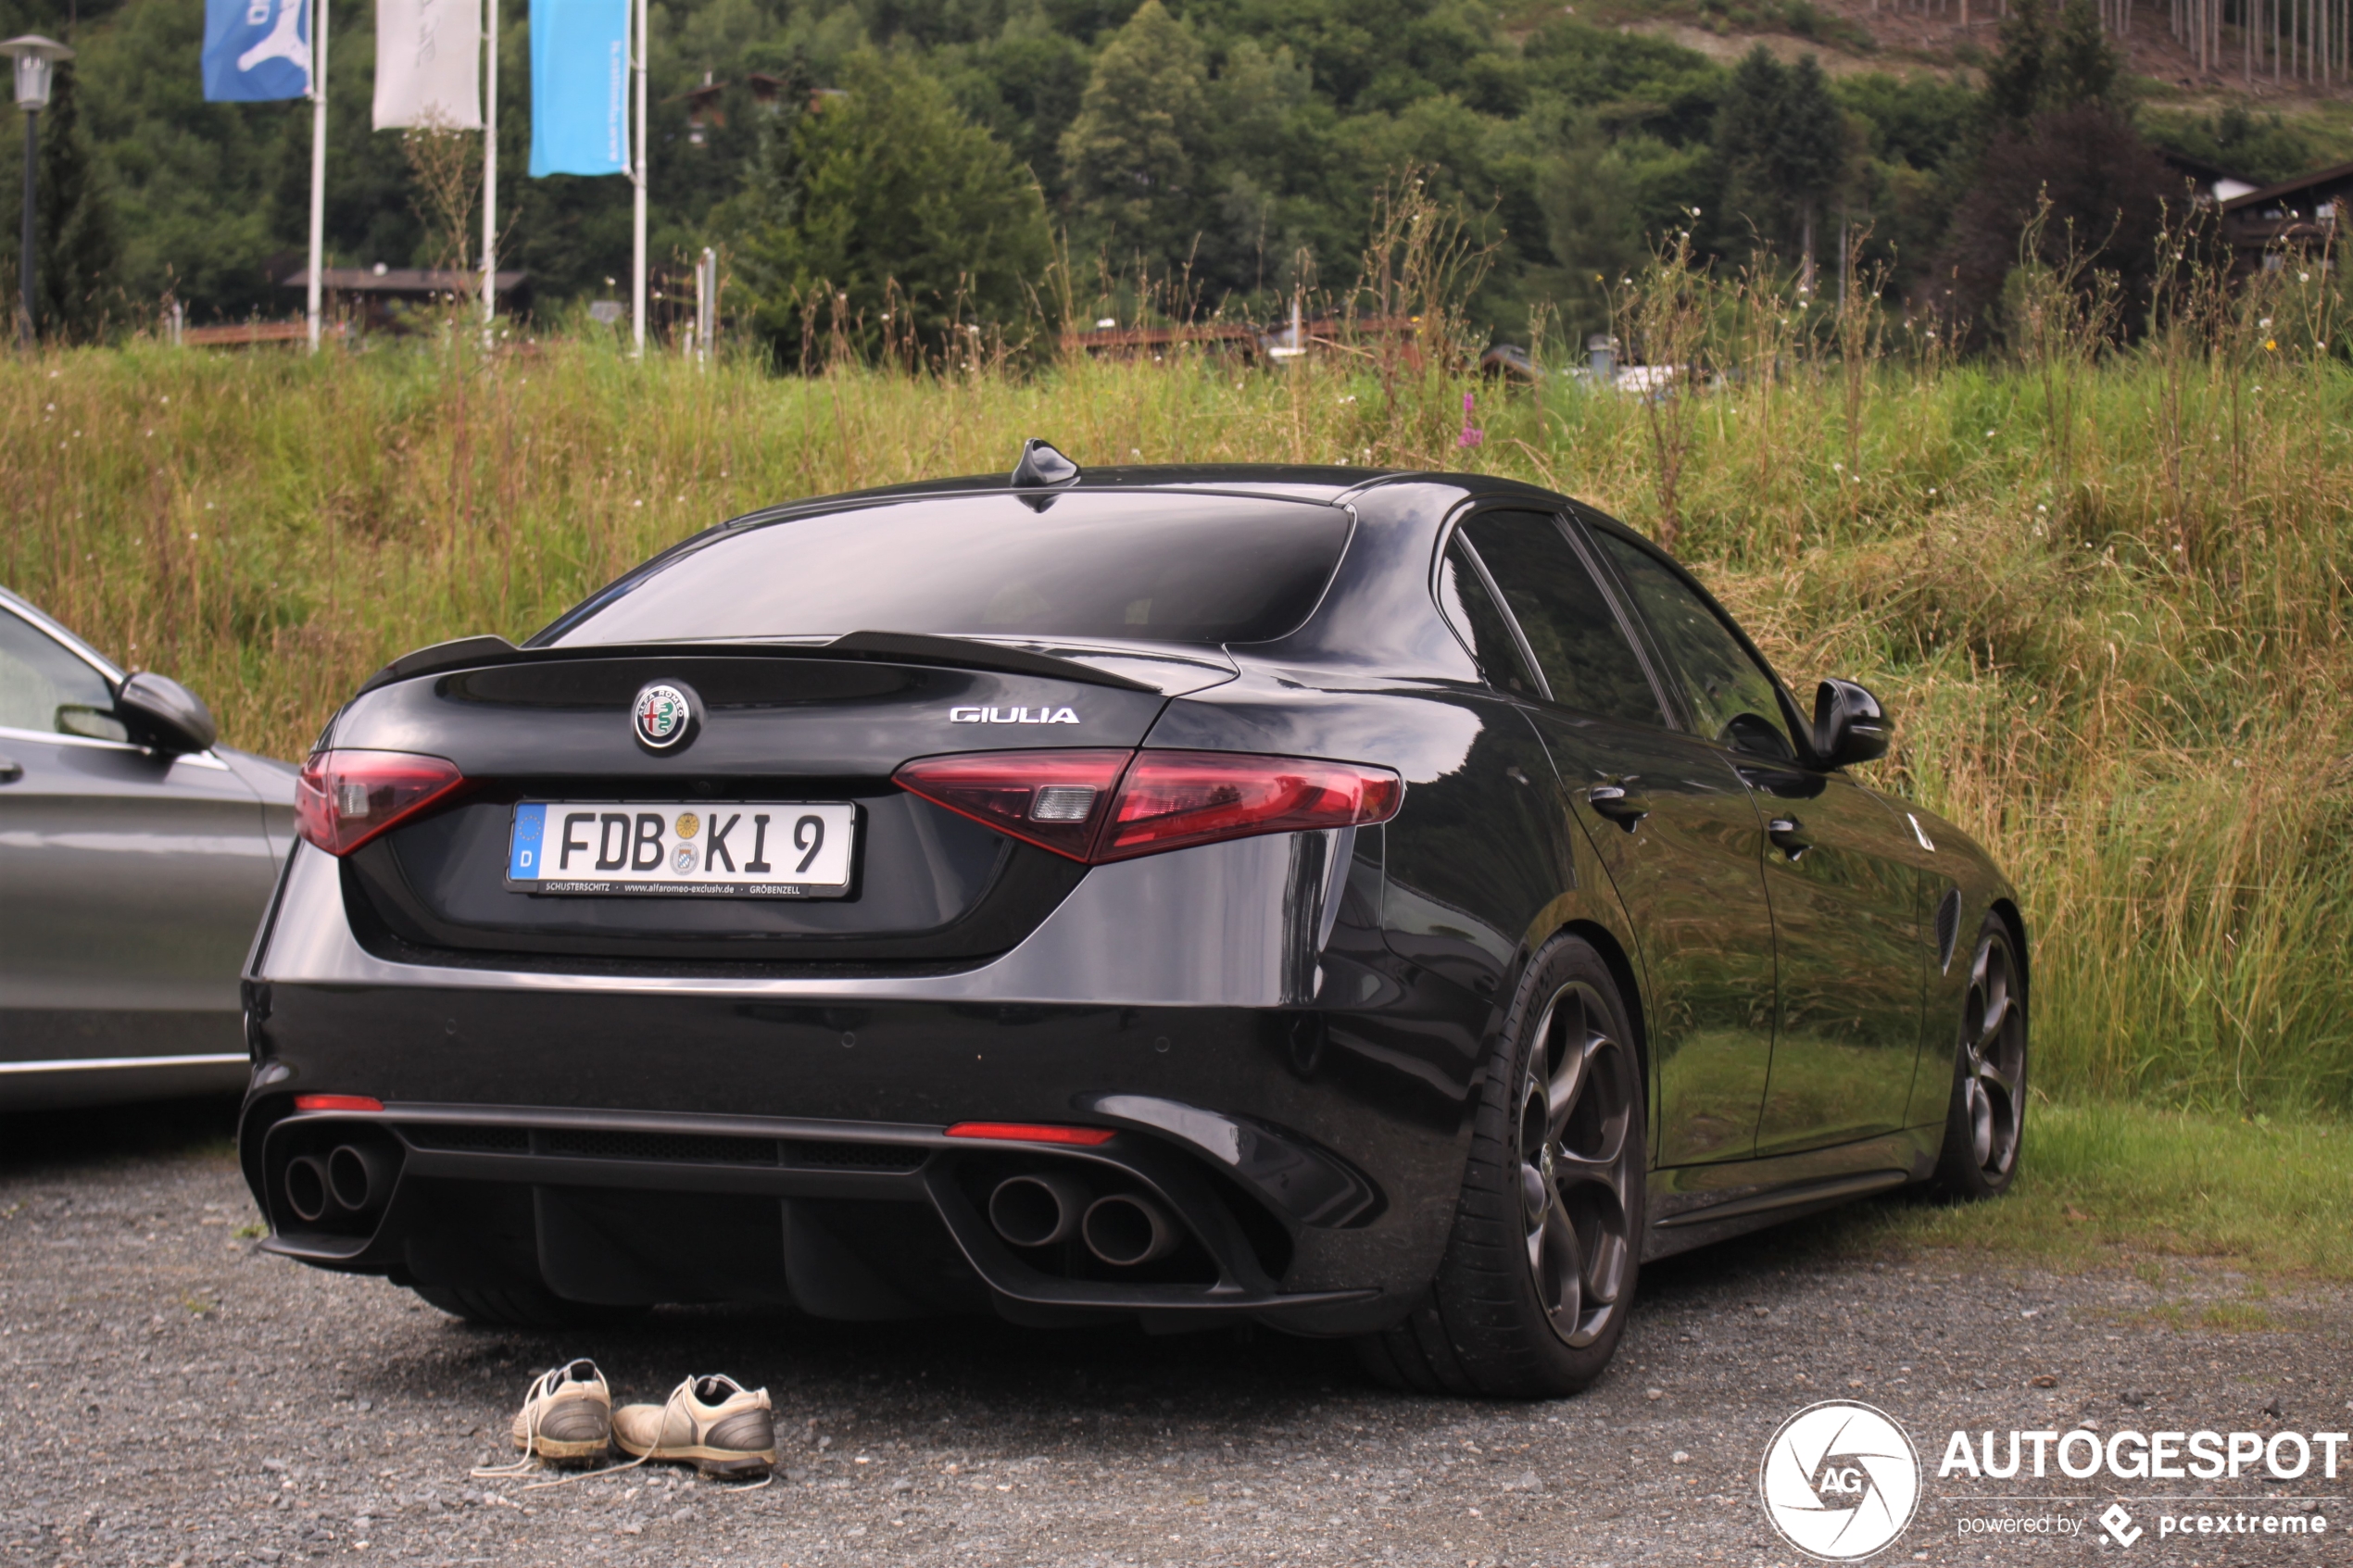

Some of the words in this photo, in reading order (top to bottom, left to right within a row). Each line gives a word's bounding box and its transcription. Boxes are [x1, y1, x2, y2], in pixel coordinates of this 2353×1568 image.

[638, 693, 655, 717] ALFA
[659, 690, 684, 718] ROMEO
[950, 707, 1080, 724] GIULIA
[559, 812, 666, 872] FDB
[704, 813, 772, 873] KI
[793, 814, 825, 873] 9
[520, 850, 533, 868] D
[546, 882, 610, 892] SCHUSTERSCHITZ
[624, 883, 735, 895] www.alfaromeo-exclusiv.de
[749, 884, 800, 895] GRÖBENZELL
